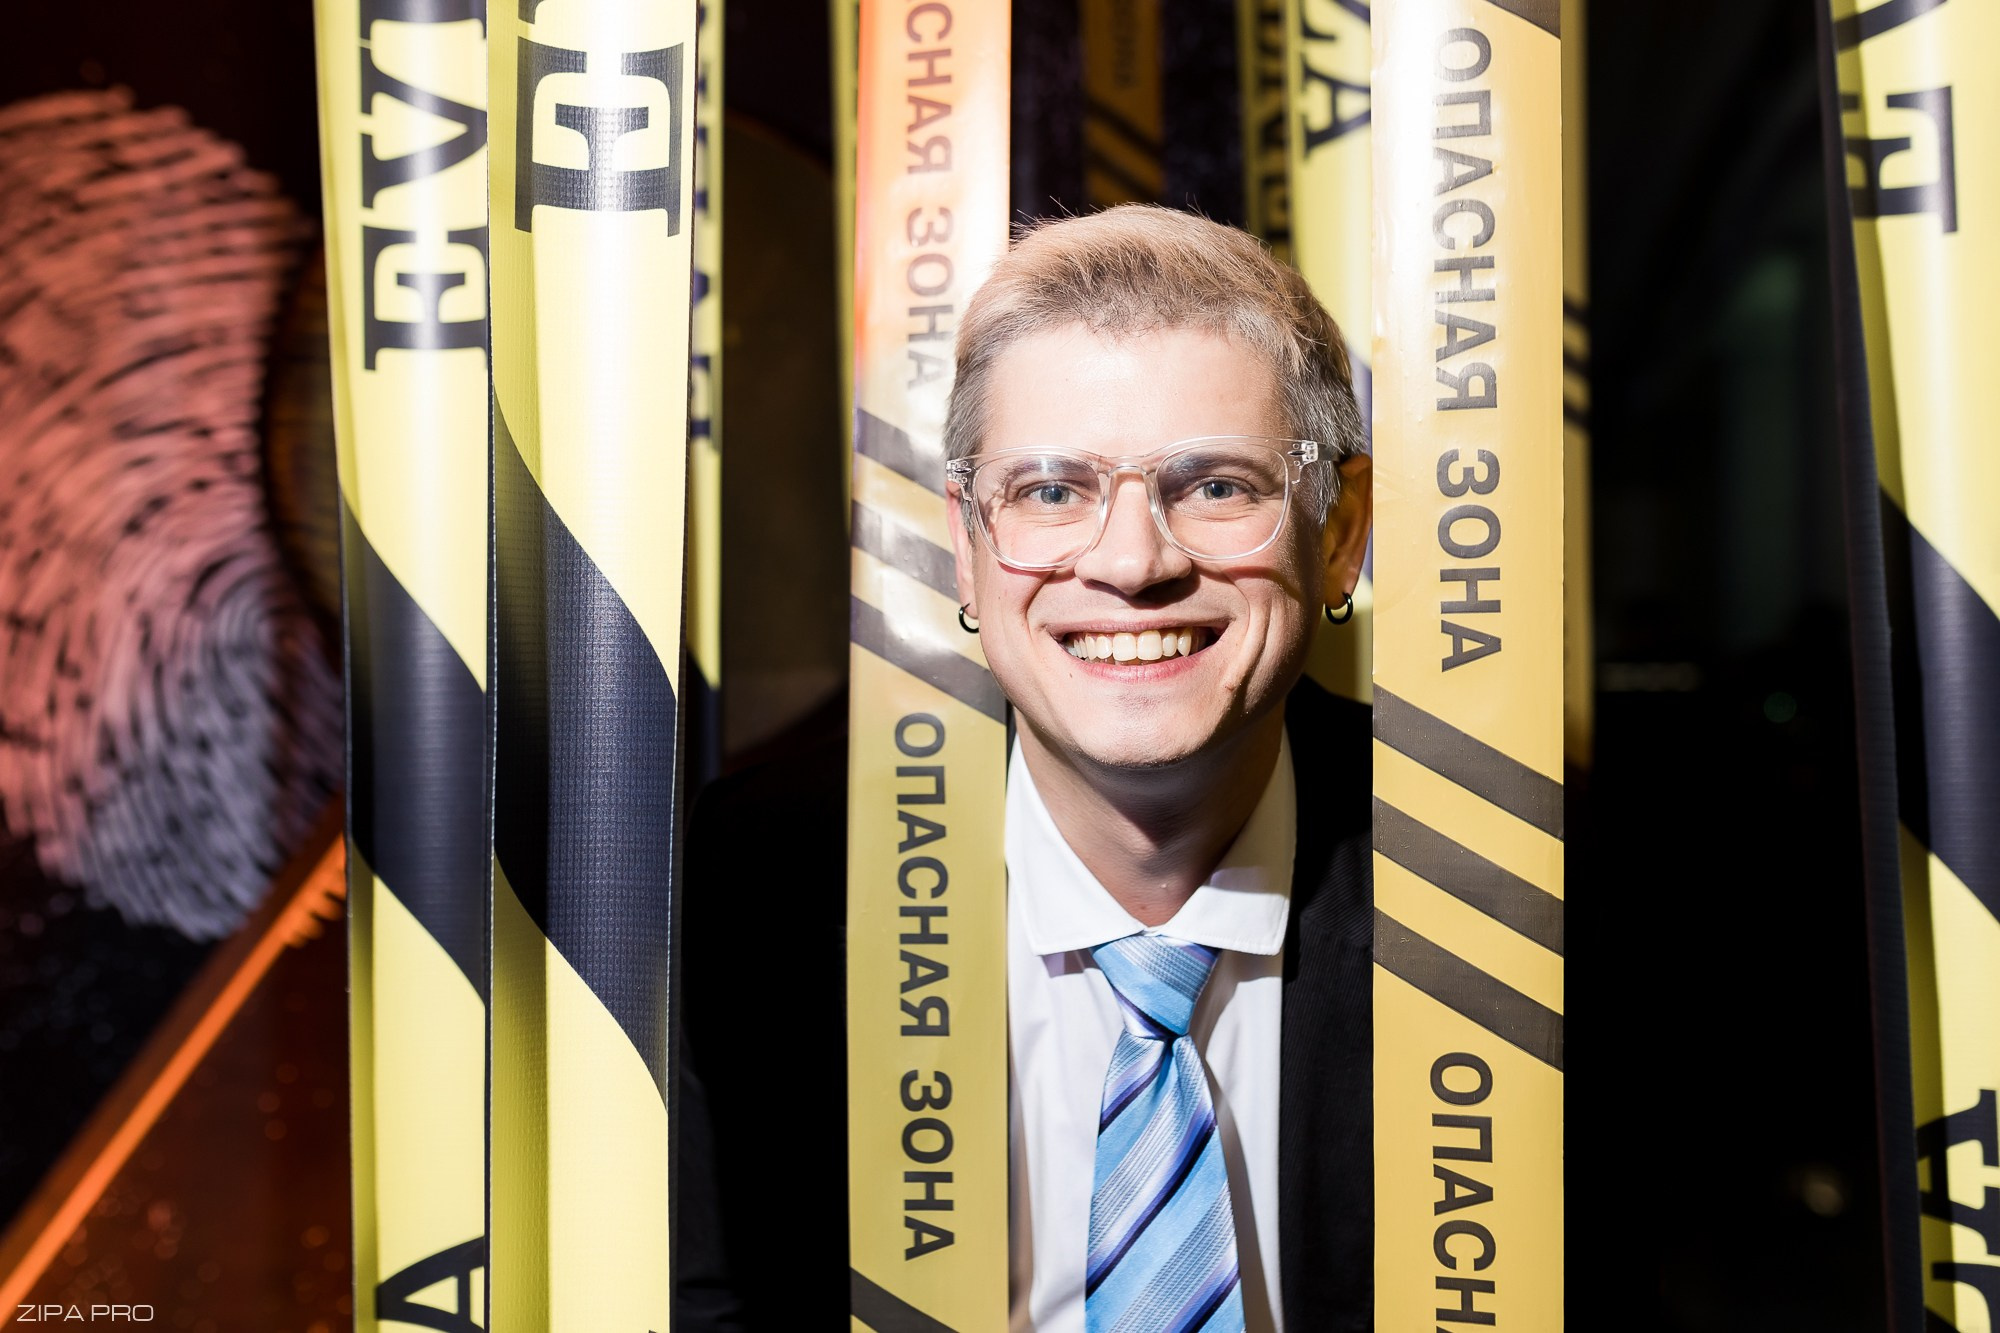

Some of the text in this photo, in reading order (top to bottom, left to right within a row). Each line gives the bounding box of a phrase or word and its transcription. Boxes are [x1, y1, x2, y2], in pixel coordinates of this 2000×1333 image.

[905, 0, 956, 391] СНАЯ ЗОНА
[1431, 27, 1502, 674] ОПАСНАЯ ЗОНА
[894, 711, 956, 1262] ОПАСНАЯ ЗОНА
[1430, 1051, 1497, 1333] ОПАСН
